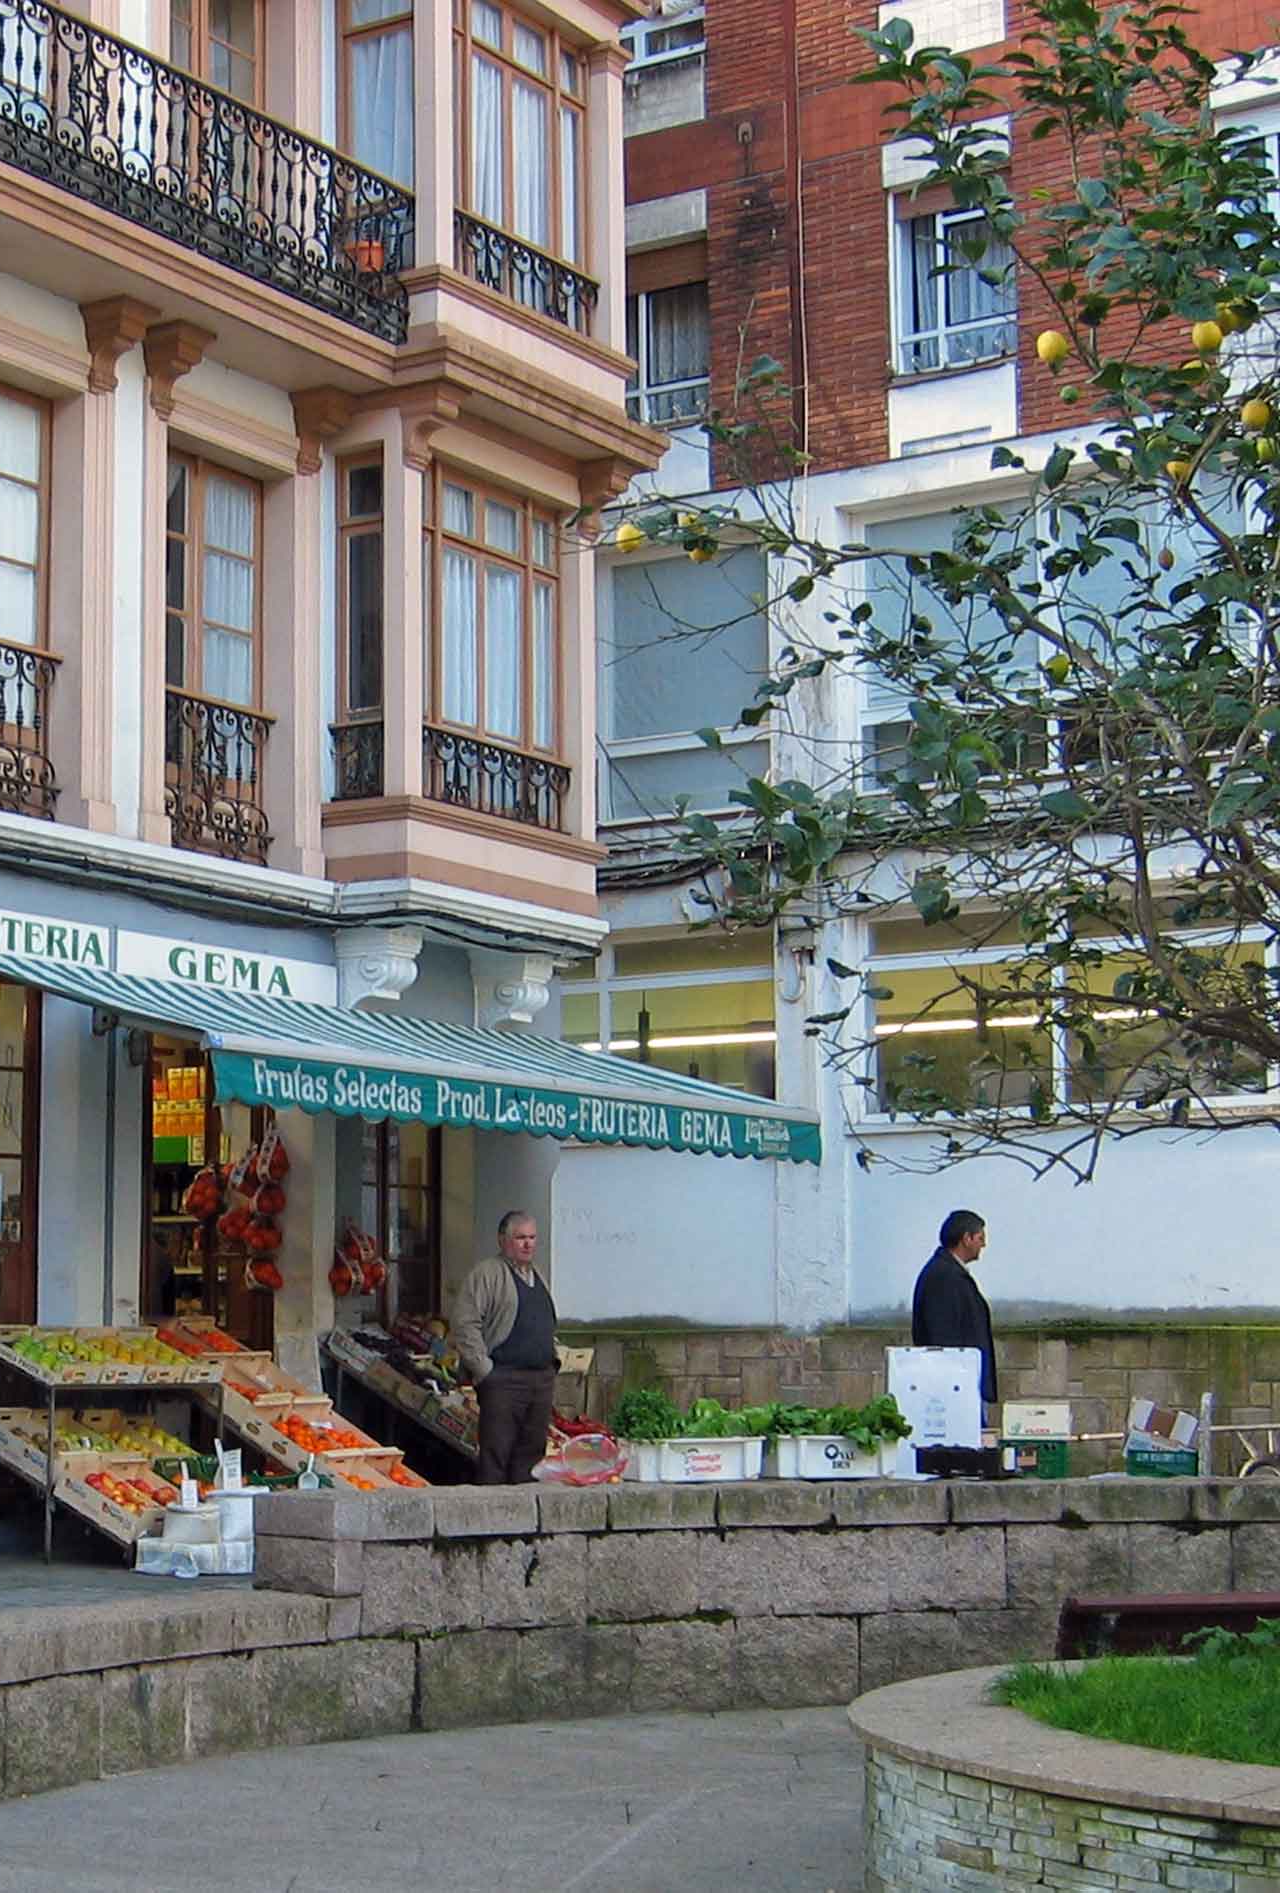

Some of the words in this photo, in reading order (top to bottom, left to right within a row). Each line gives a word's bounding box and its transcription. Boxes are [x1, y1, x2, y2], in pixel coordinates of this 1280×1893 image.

[169, 947, 293, 997] GEMA
[253, 1059, 328, 1105] Frutas
[334, 1067, 422, 1114] Selectas
[579, 1097, 669, 1142] FRUTERIA
[681, 1111, 733, 1149] GEMA
